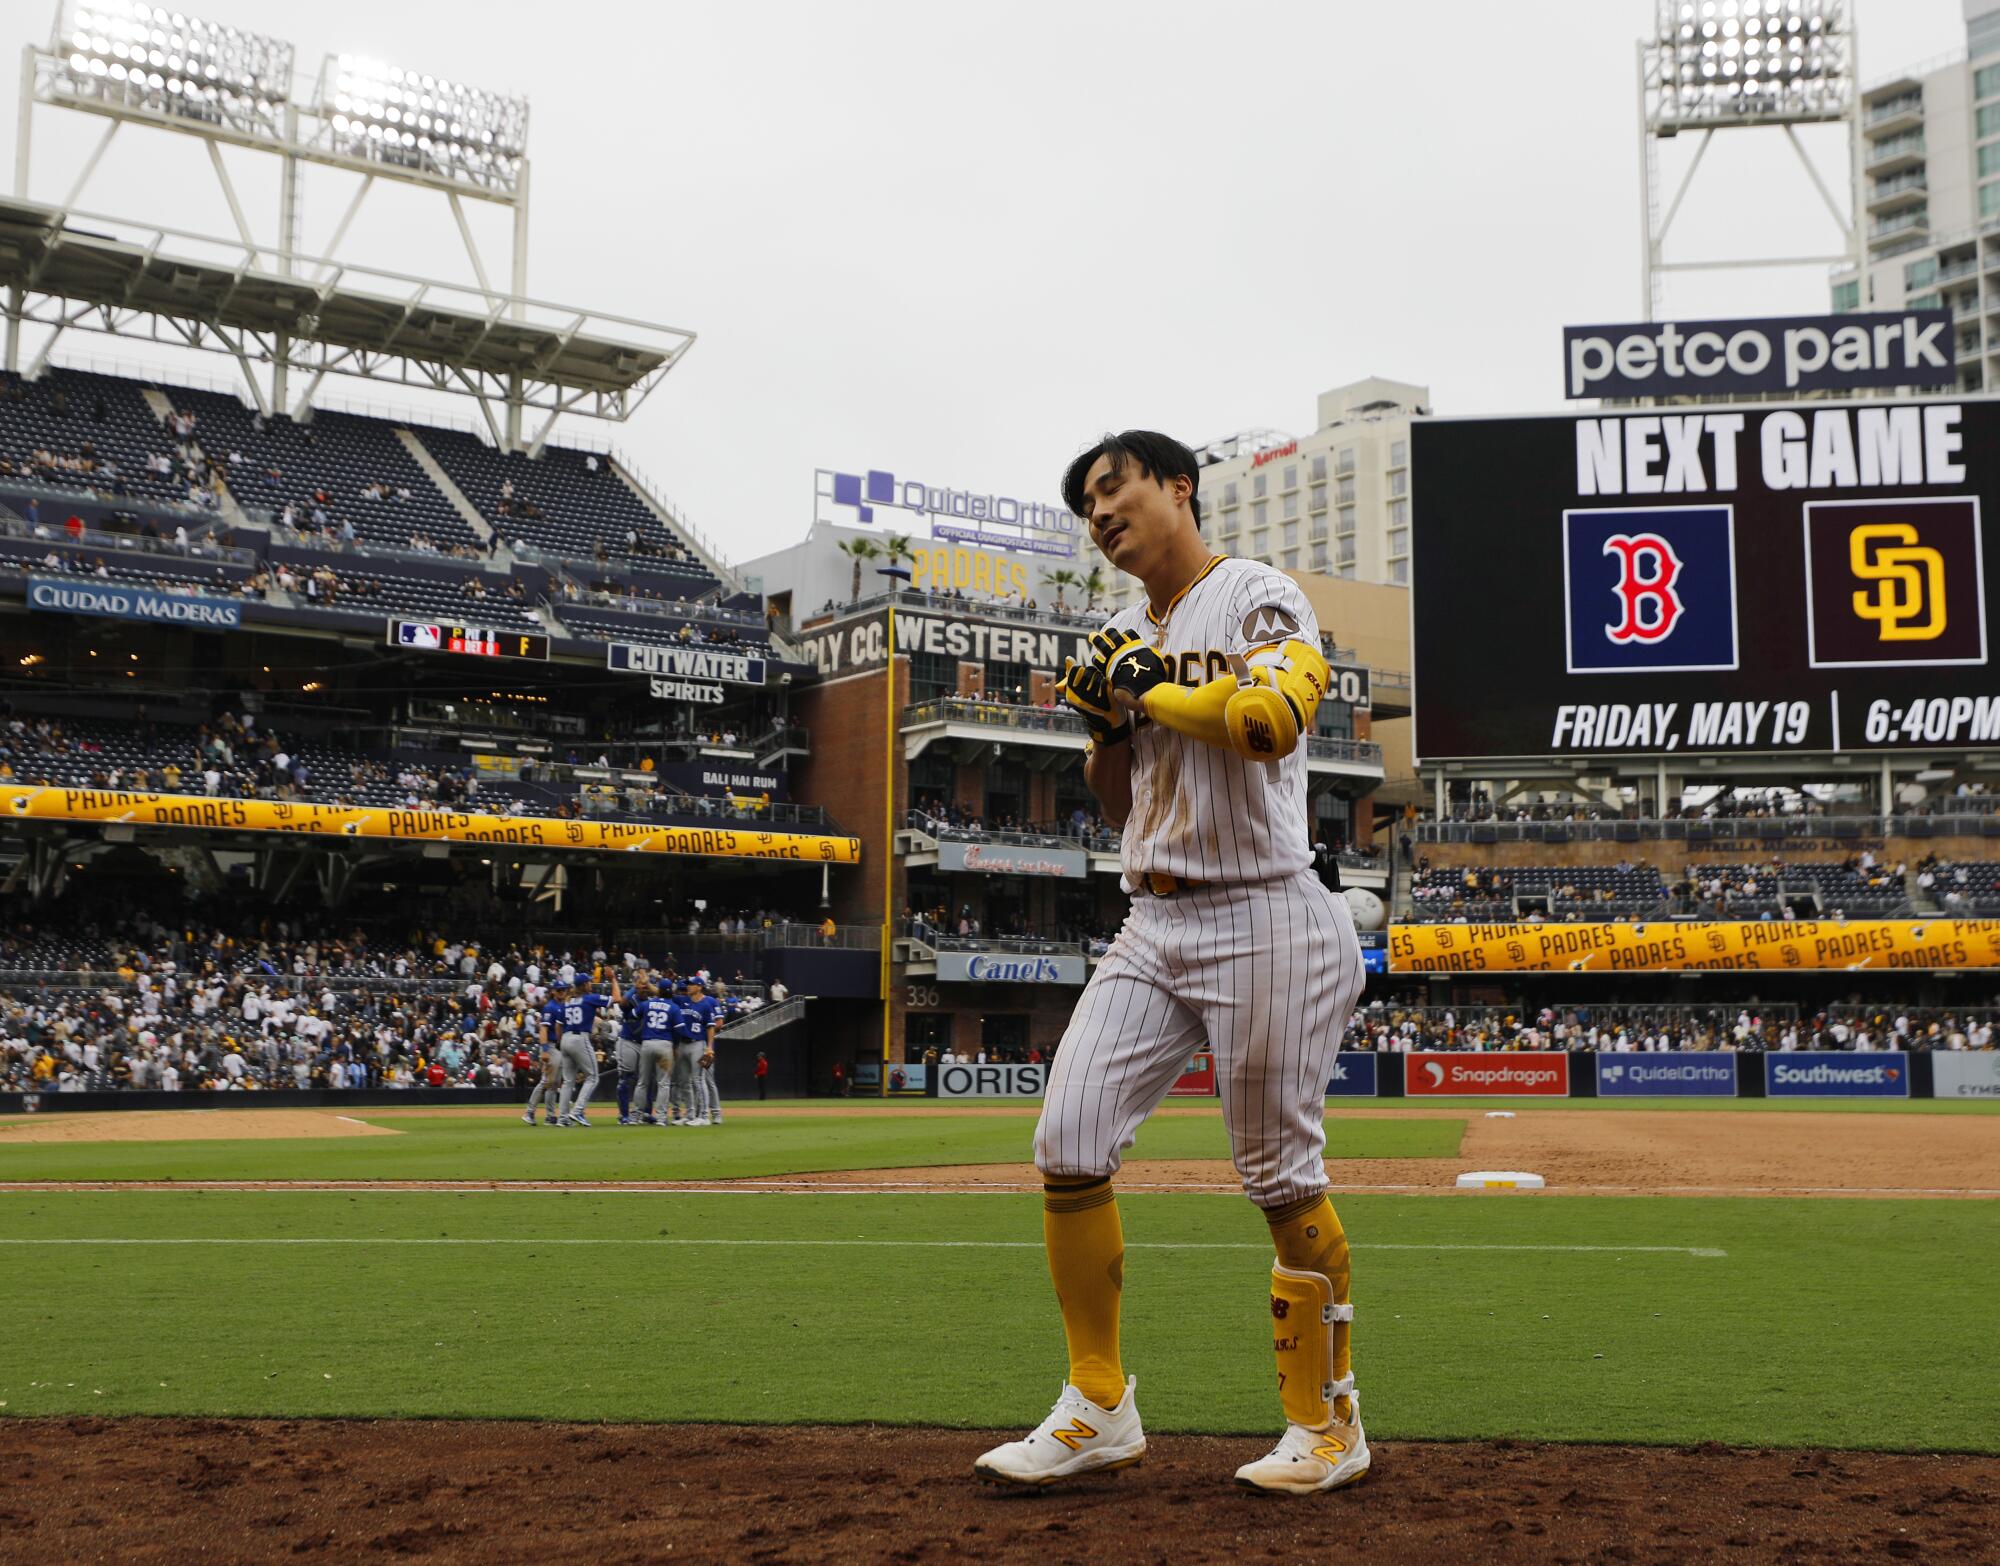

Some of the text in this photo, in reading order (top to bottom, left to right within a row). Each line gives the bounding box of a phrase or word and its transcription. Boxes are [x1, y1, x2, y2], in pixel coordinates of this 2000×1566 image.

[1570, 317, 1949, 395] petco park
[1576, 405, 1966, 495] NEXT GAME
[904, 481, 1073, 533] QuidelOrtho
[939, 527, 1070, 554] OFFICIAL DIAGNOSTICS PARTNER
[912, 548, 1028, 598] PADRES
[1603, 532, 1685, 645] B
[33, 585, 238, 626] CIUDAD MADERAS
[520, 636, 529, 656] F
[851, 621, 888, 666] CO.
[894, 614, 1058, 667] WESTERN
[628, 646, 749, 682] CUTWATER
[650, 679, 725, 704] SPIRITS
[1552, 700, 1811, 751] FRIDAY, MAY 19
[1865, 696, 2000, 742] 6:40PM
[703, 771, 777, 789] BALI HAI RUM
[666, 830, 736, 854] PADRES
[1541, 924, 1616, 957] PADRES
[1610, 937, 1687, 970] PADRES
[1815, 927, 1895, 961] PADRES
[1887, 940, 1967, 969] PADRES
[967, 955, 1060, 983] Canel's
[907, 985, 939, 1006] 336
[565, 1006, 583, 1025] 58
[647, 1011, 669, 1029] 32
[943, 1066, 1041, 1094] ORIS
[1451, 1066, 1558, 1086] Snapdragon
[1629, 1066, 1731, 1082] QuidelOrtho
[1774, 1064, 1885, 1084] Southwest
